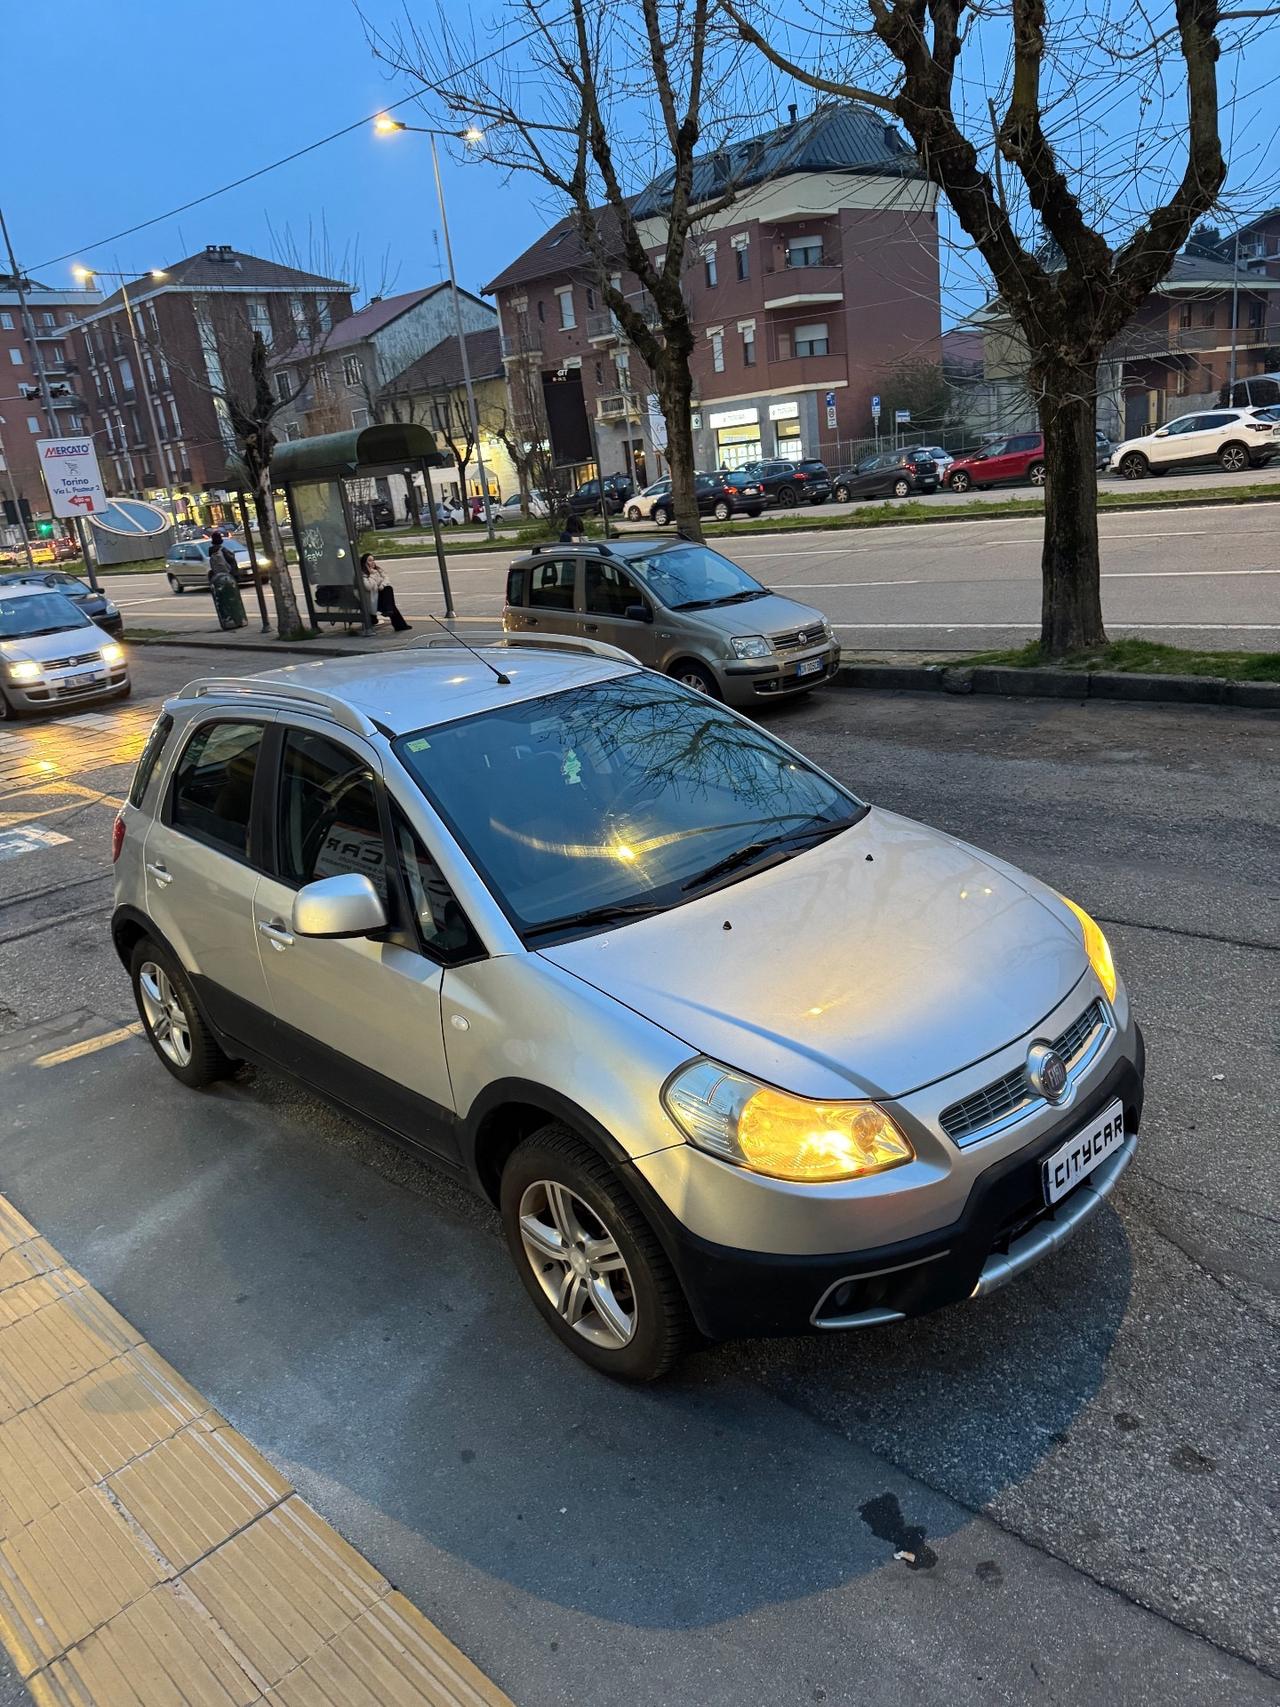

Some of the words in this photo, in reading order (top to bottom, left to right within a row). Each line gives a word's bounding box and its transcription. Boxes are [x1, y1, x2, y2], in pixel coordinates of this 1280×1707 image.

[872, 397, 879, 406] P
[61, 477, 89, 487] Torino
[1048, 1062, 1065, 1088] FIAT
[1055, 1114, 1123, 1189] CITYCAR
